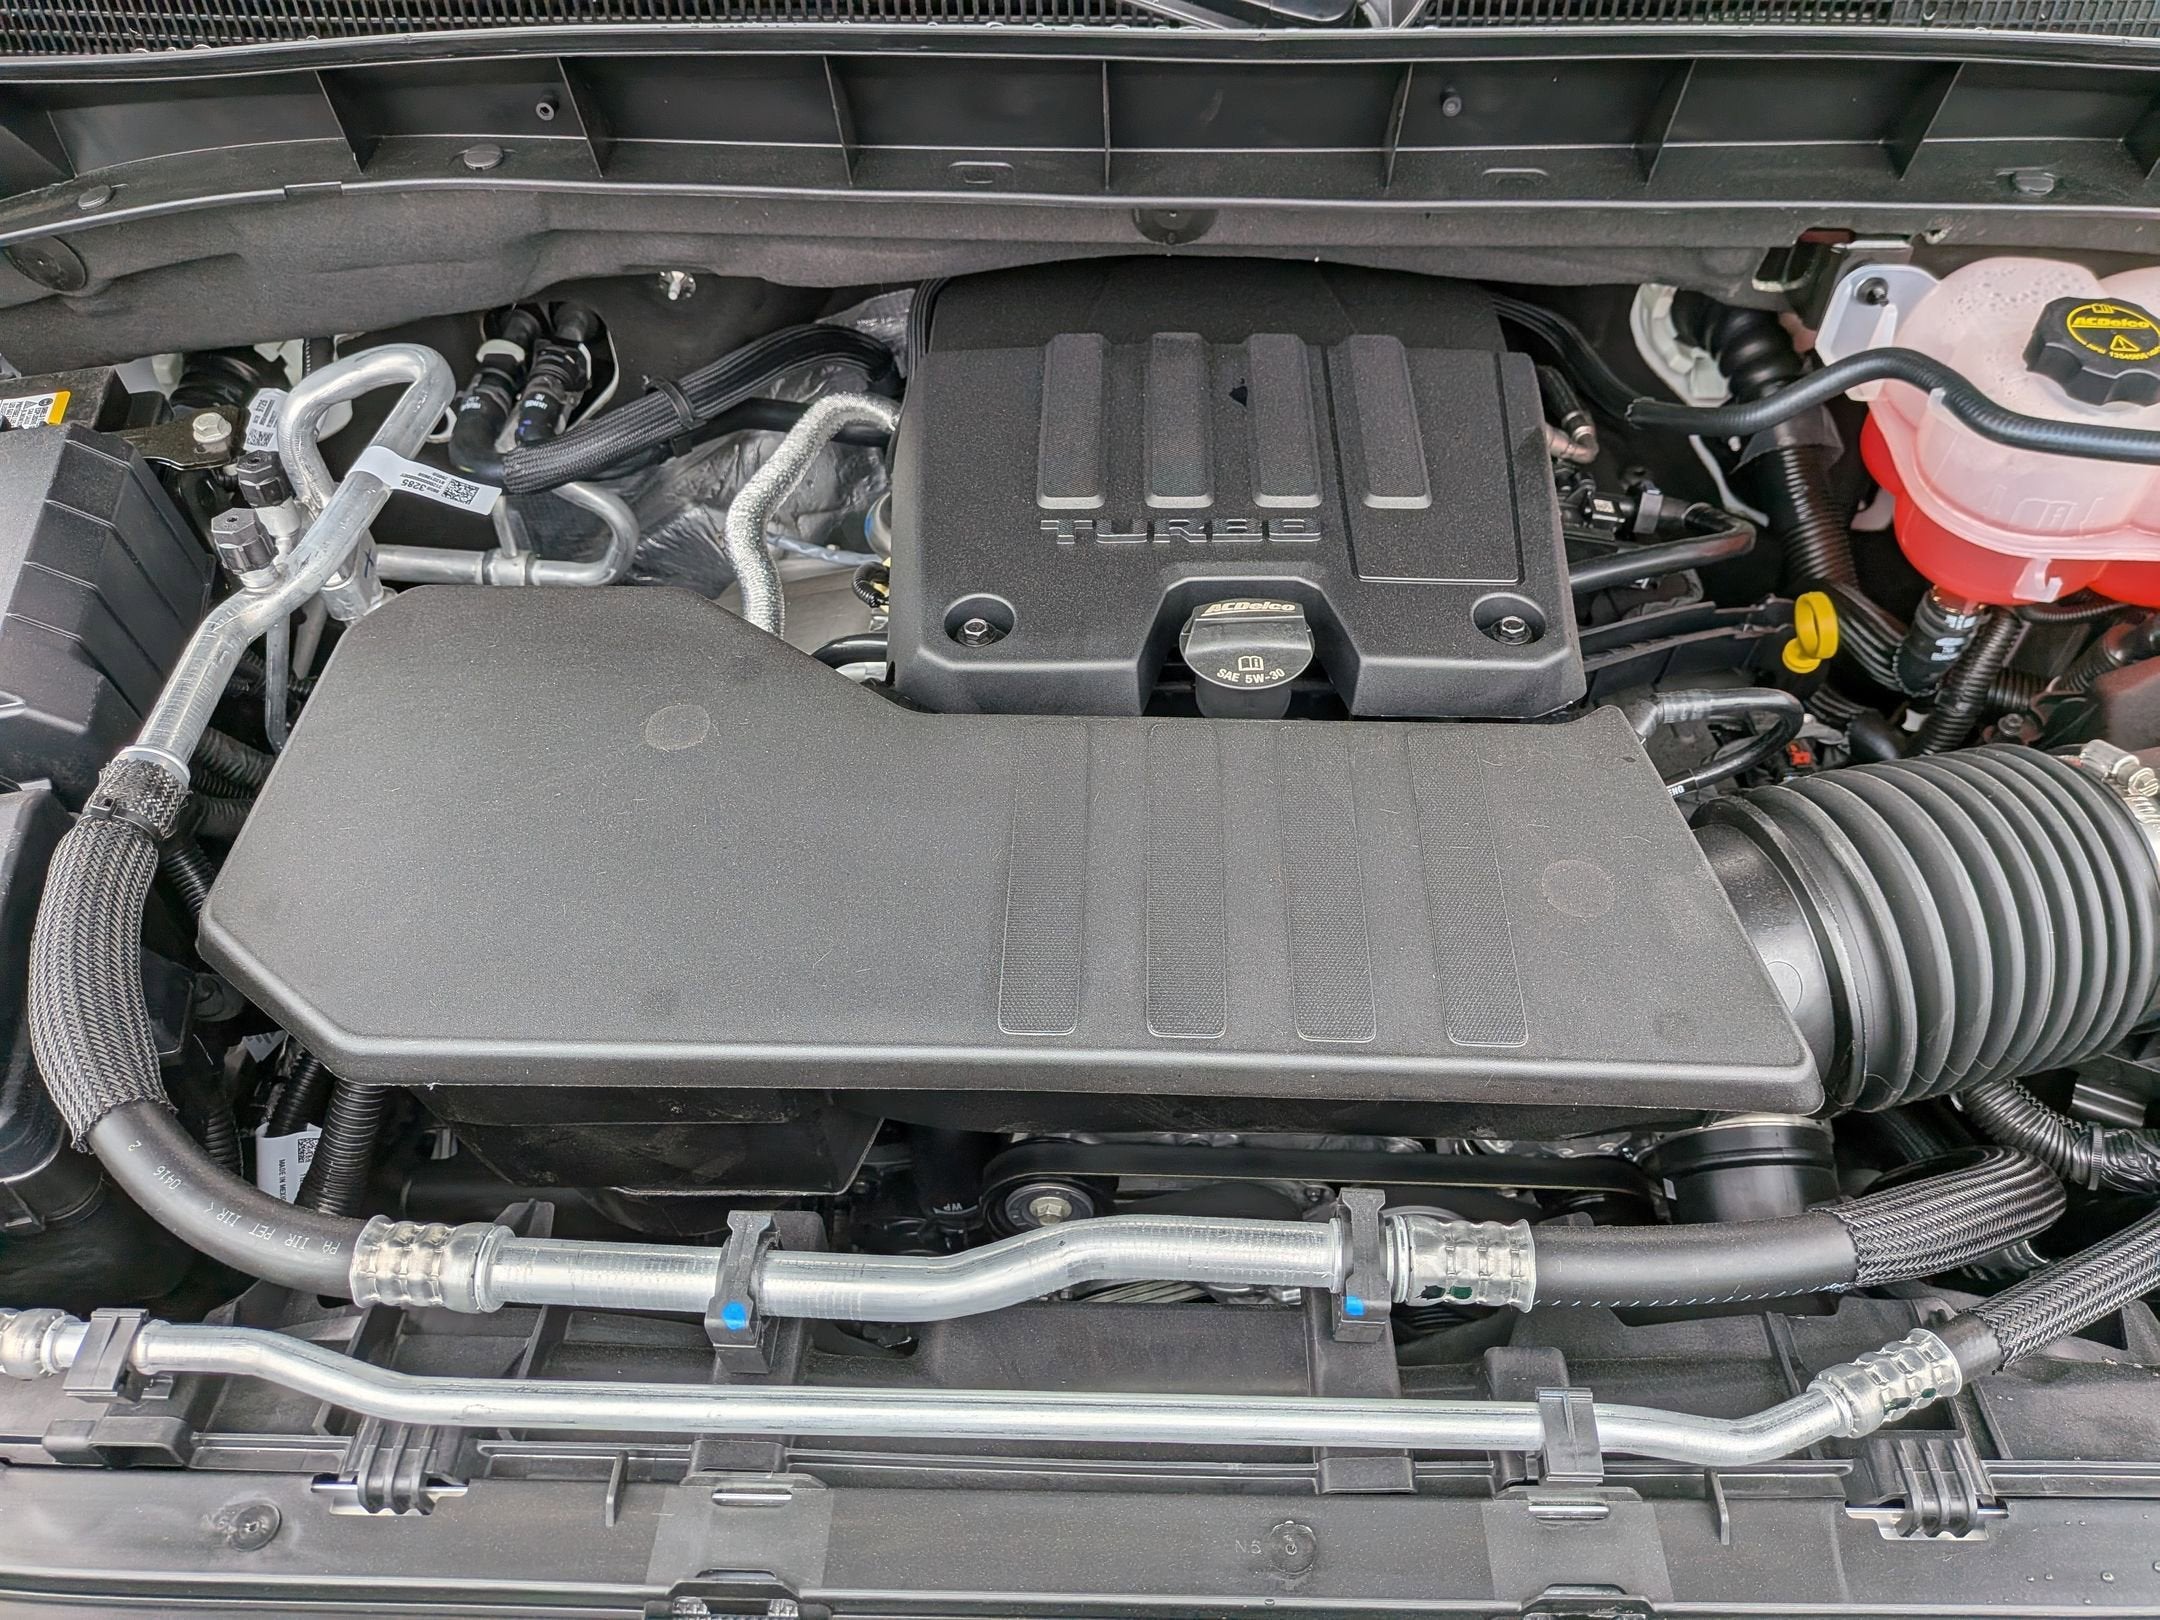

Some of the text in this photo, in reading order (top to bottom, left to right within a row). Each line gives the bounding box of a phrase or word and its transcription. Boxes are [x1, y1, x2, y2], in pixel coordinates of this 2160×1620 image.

[2071, 316, 2151, 328] ACDelco
[401, 478, 427, 492] 3285
[1040, 518, 1321, 545] TURBO
[1201, 601, 1296, 617] ACDelco
[1216, 668, 1286, 684] SAE 5W-30
[279, 1159, 287, 1176] MADE
[152, 1165, 182, 1190] 0416
[279, 1176, 287, 1184] IN
[248, 1223, 276, 1240] PET
